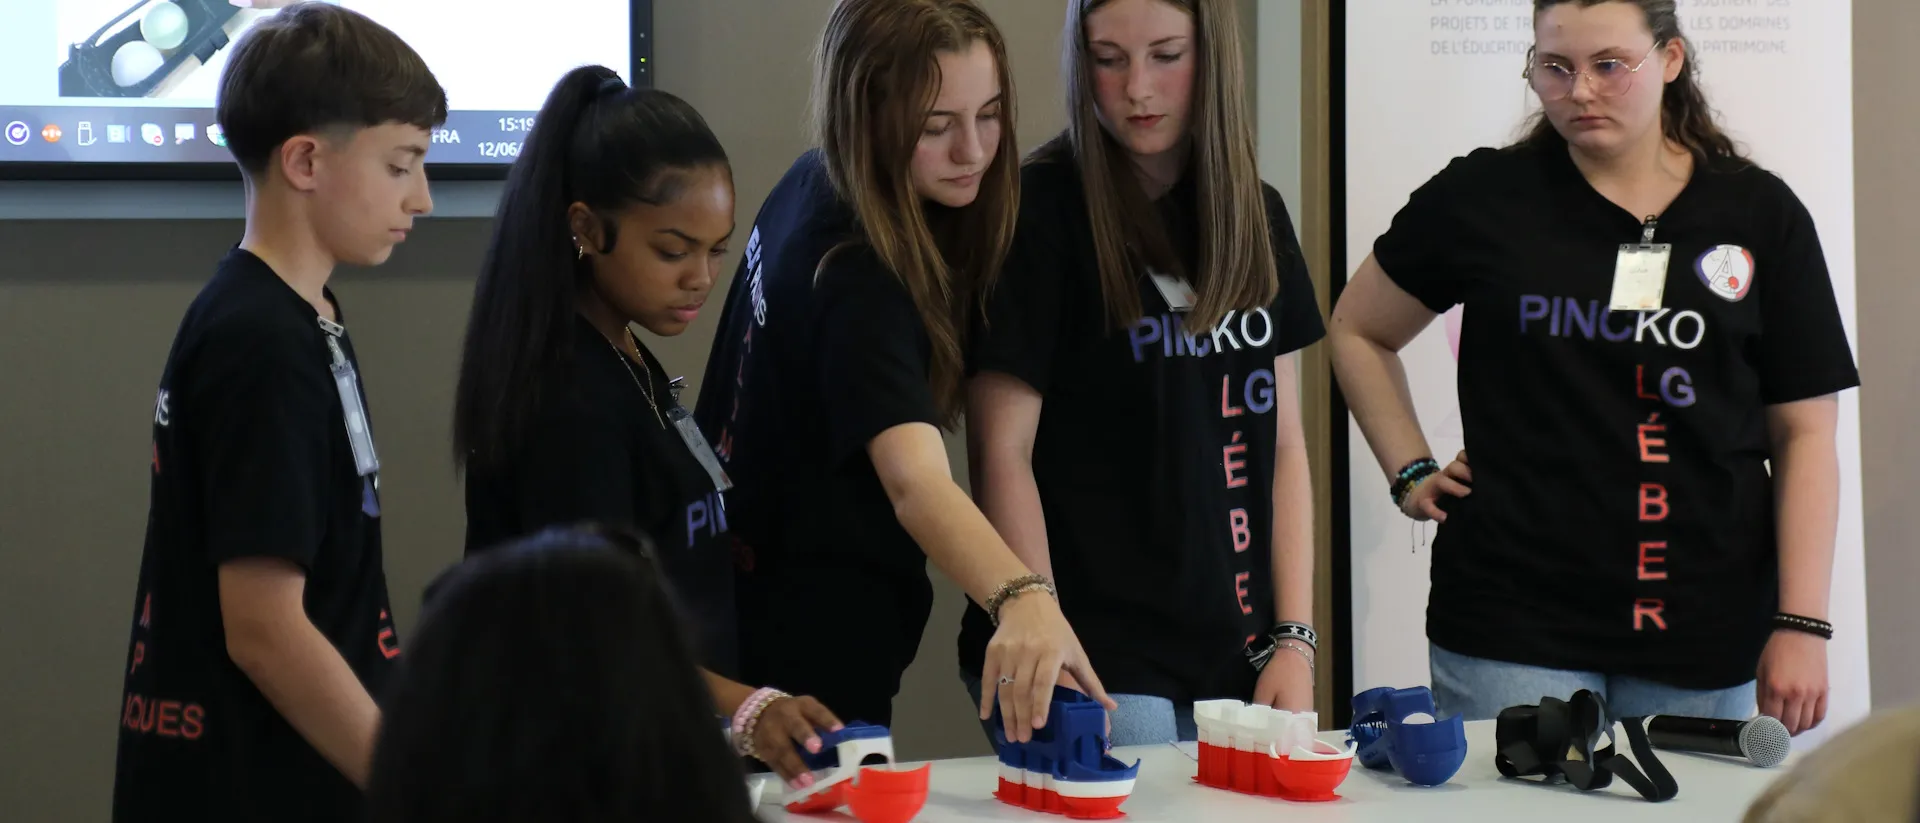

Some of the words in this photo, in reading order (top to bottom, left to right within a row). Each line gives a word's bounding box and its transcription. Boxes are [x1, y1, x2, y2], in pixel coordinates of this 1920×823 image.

[1430, 16, 1488, 32] PROJETS
[1494, 16, 1510, 30] DE
[1719, 16, 1791, 30] DOMAINES
[498, 117, 535, 132] 15:19
[431, 129, 461, 144] FRA
